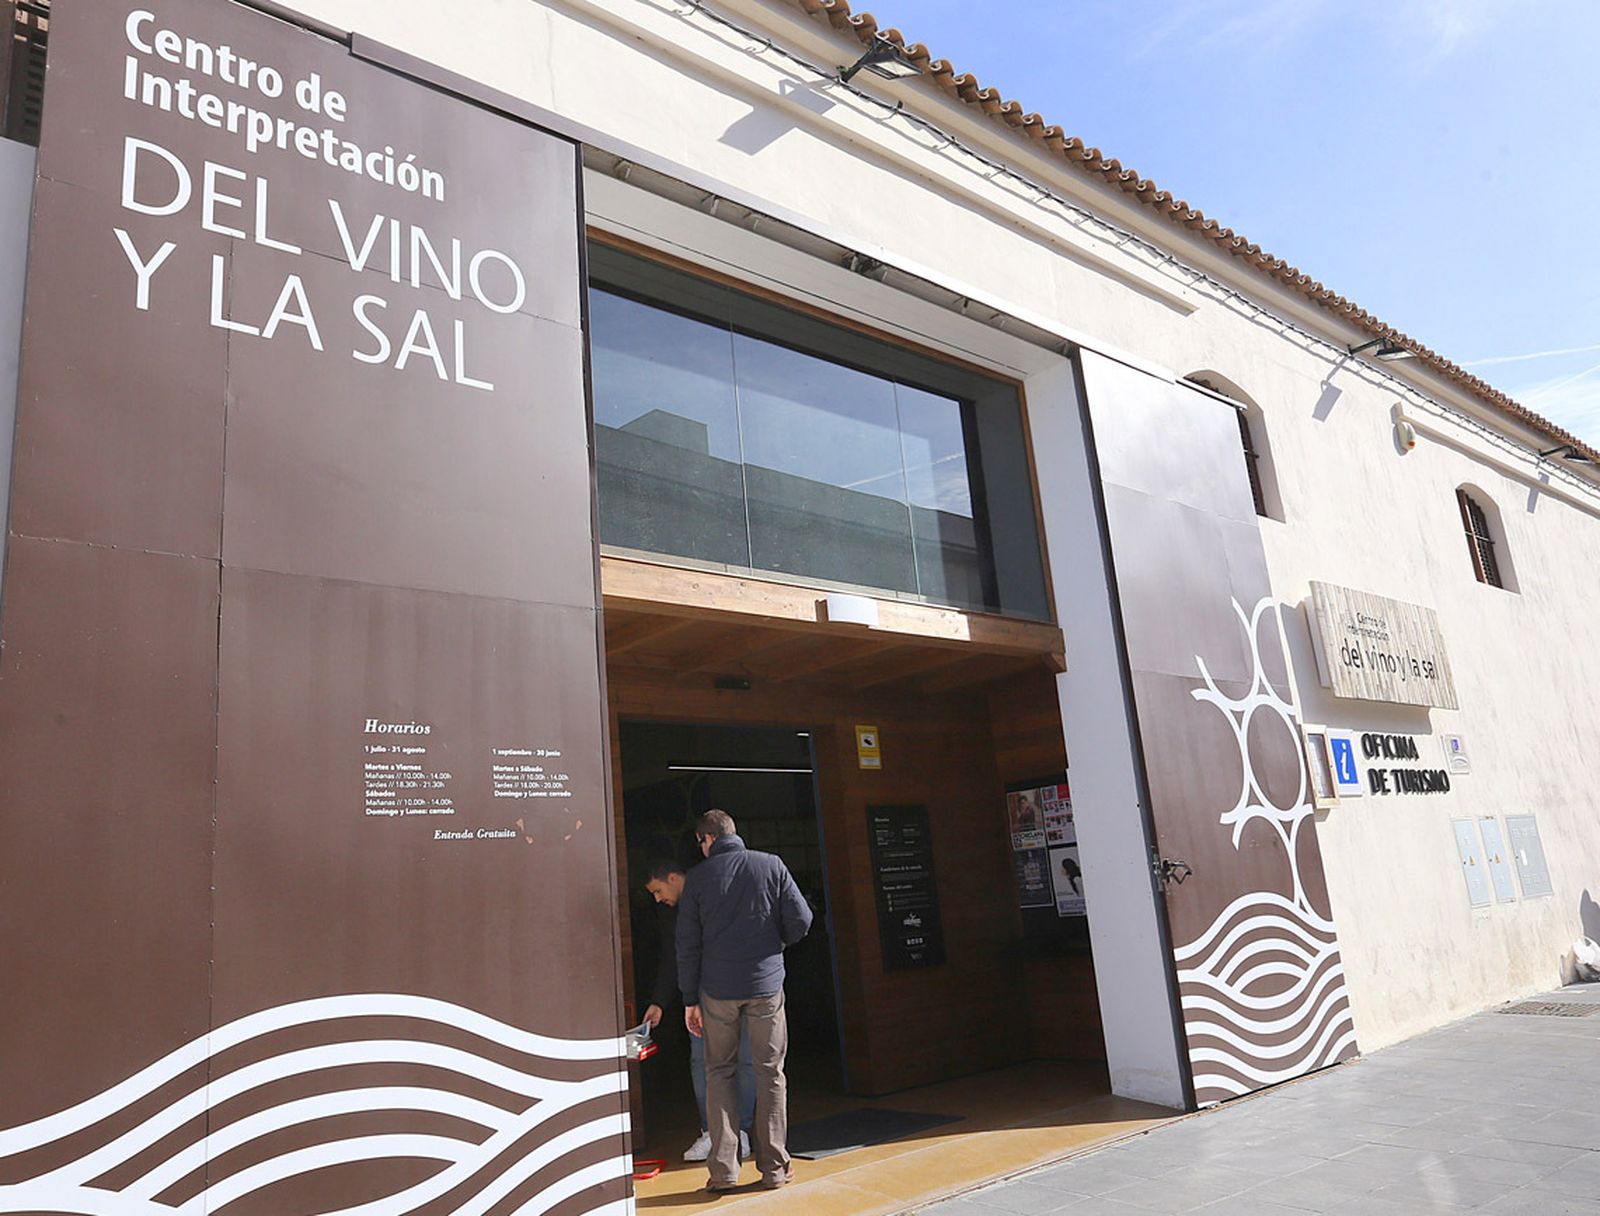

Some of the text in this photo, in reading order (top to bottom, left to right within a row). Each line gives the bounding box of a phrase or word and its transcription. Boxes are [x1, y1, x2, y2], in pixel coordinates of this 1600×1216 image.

[124, 9, 347, 122] Centro de
[124, 55, 445, 202] Interpretación
[120, 135, 526, 315] DEL VINO
[112, 227, 494, 391] Y LA SAL
[1341, 637, 1440, 682] del vino y la sal
[364, 718, 431, 736] Horarios
[1360, 733, 1420, 761] OFICINA
[494, 790, 522, 798] Domingo
[1367, 768, 1451, 796] DE TURISMO
[366, 808, 398, 816] Domingo
[434, 828, 517, 840] Entrada Gratuita
